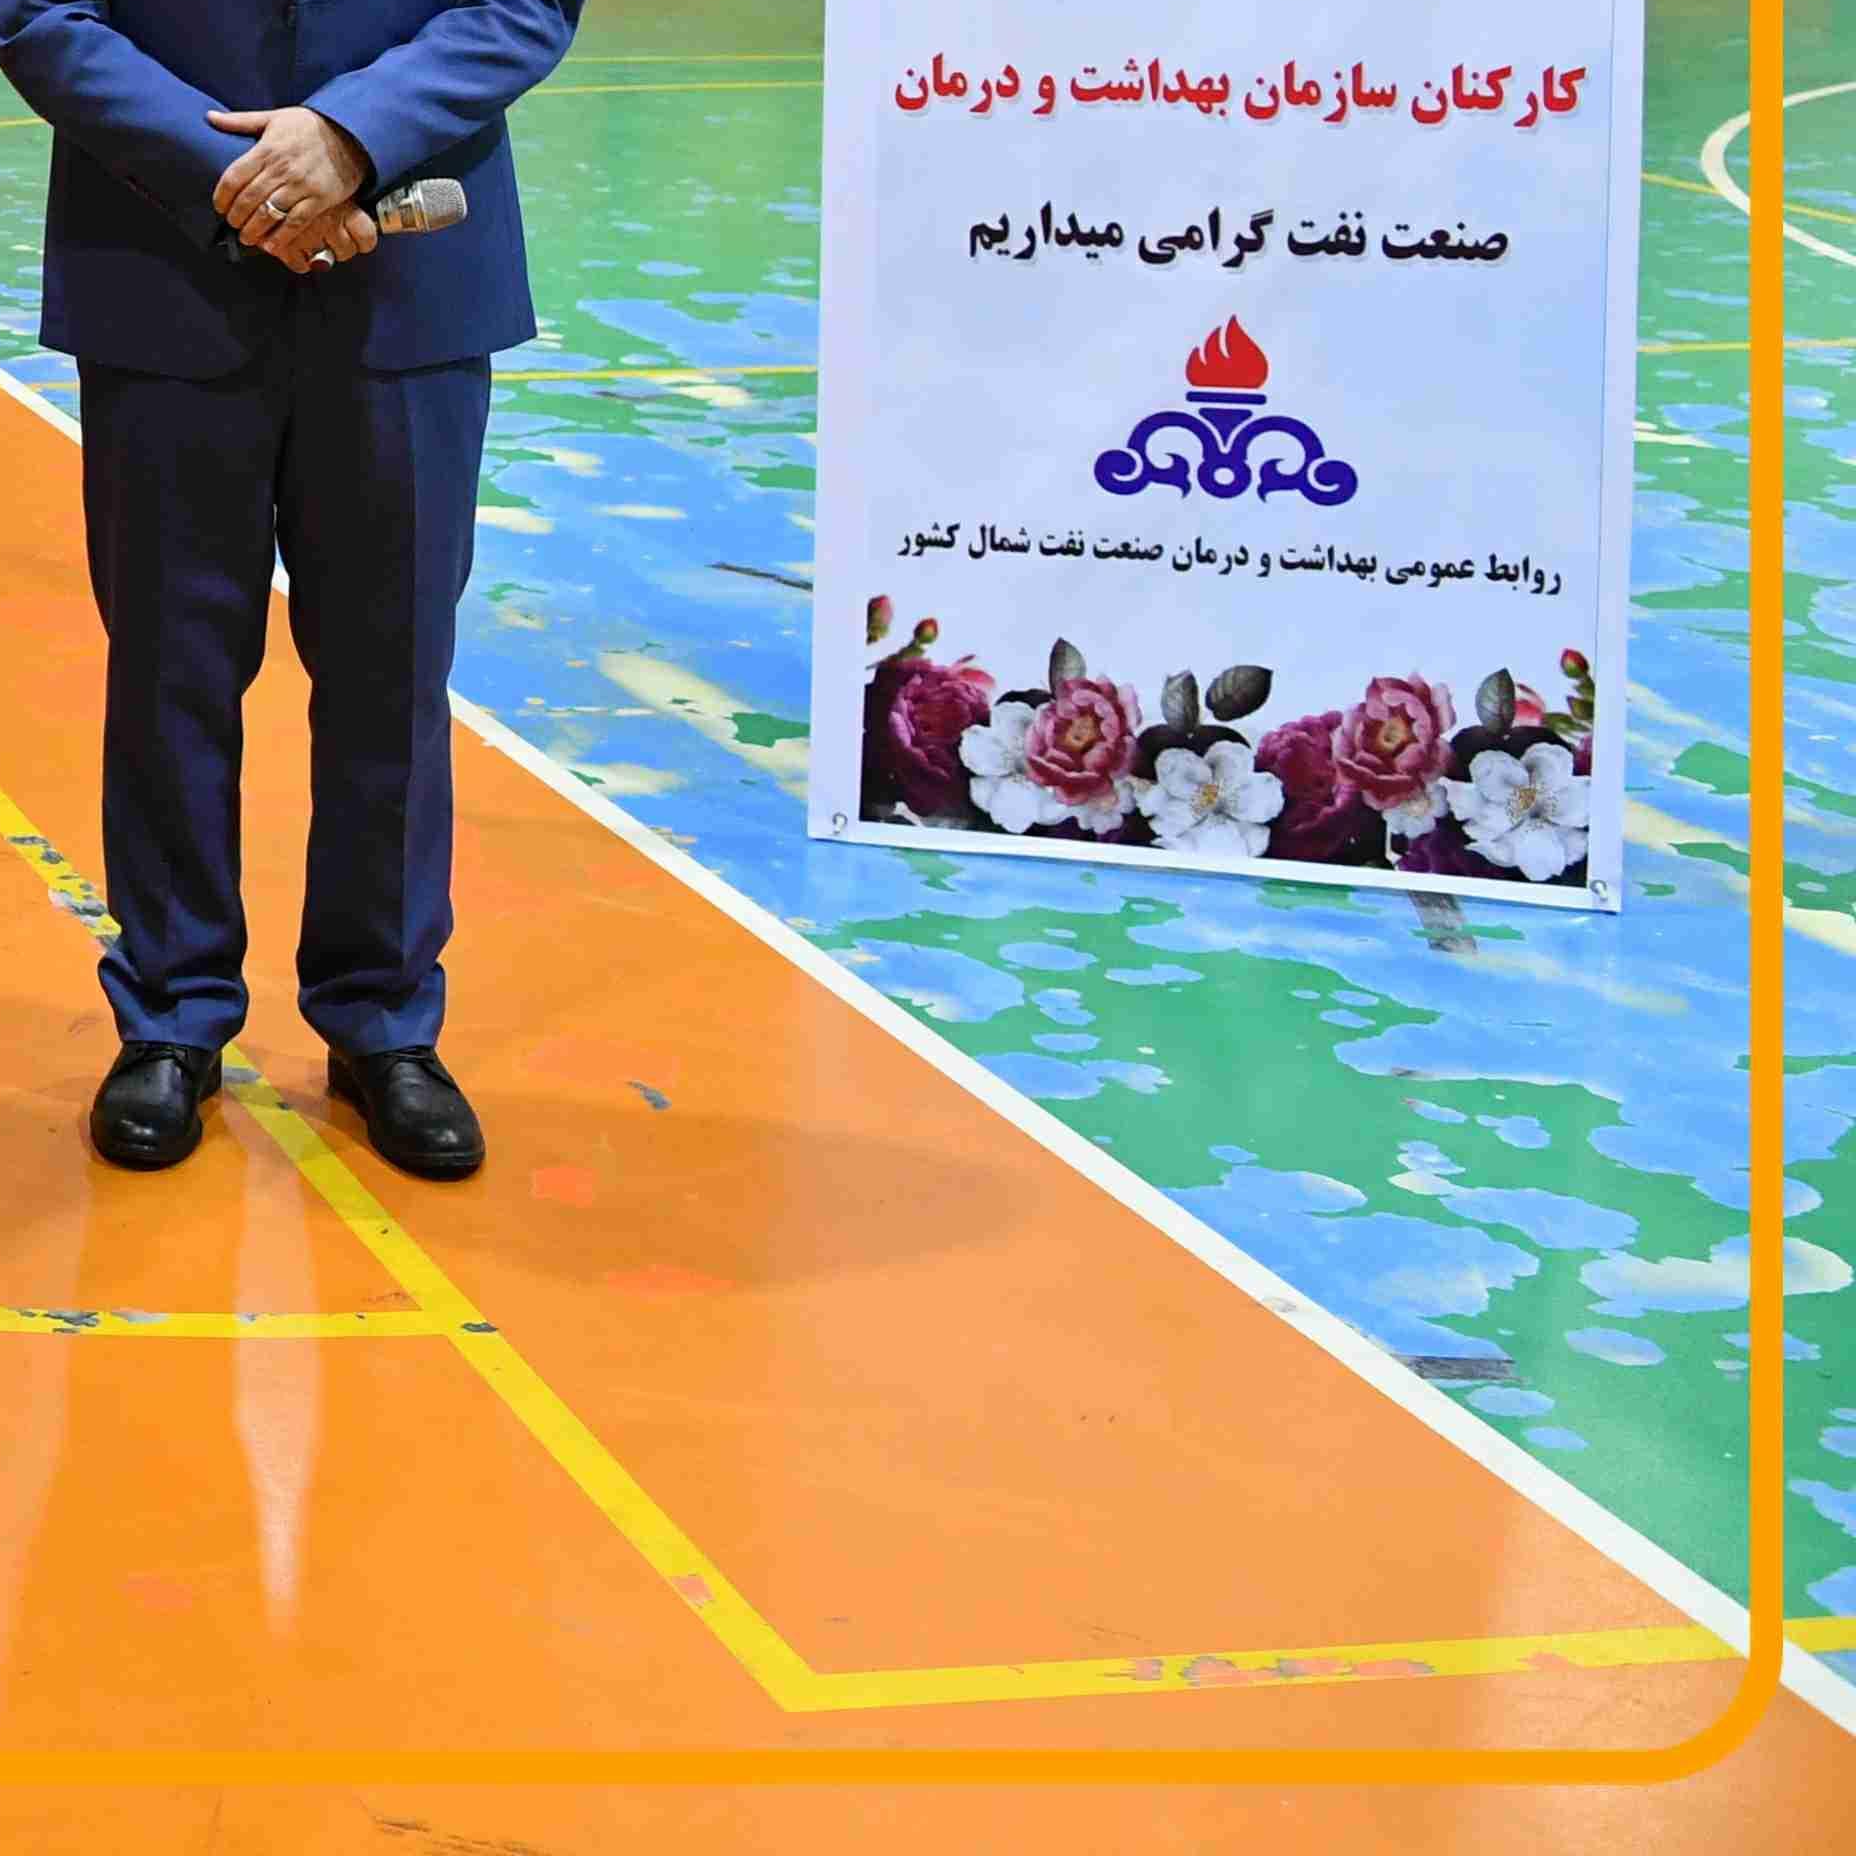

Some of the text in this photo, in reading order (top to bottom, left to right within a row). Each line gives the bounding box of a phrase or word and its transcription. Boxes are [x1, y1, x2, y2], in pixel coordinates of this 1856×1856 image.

[895, 56, 1586, 128] کارکنان سازمان بهداشت و درمان
[970, 202, 1509, 269] صنعت نفت گرامی میداریم
[897, 522, 1562, 595] روابط عمومی بهداشت و درمان صنعت نفت شمال کشور
